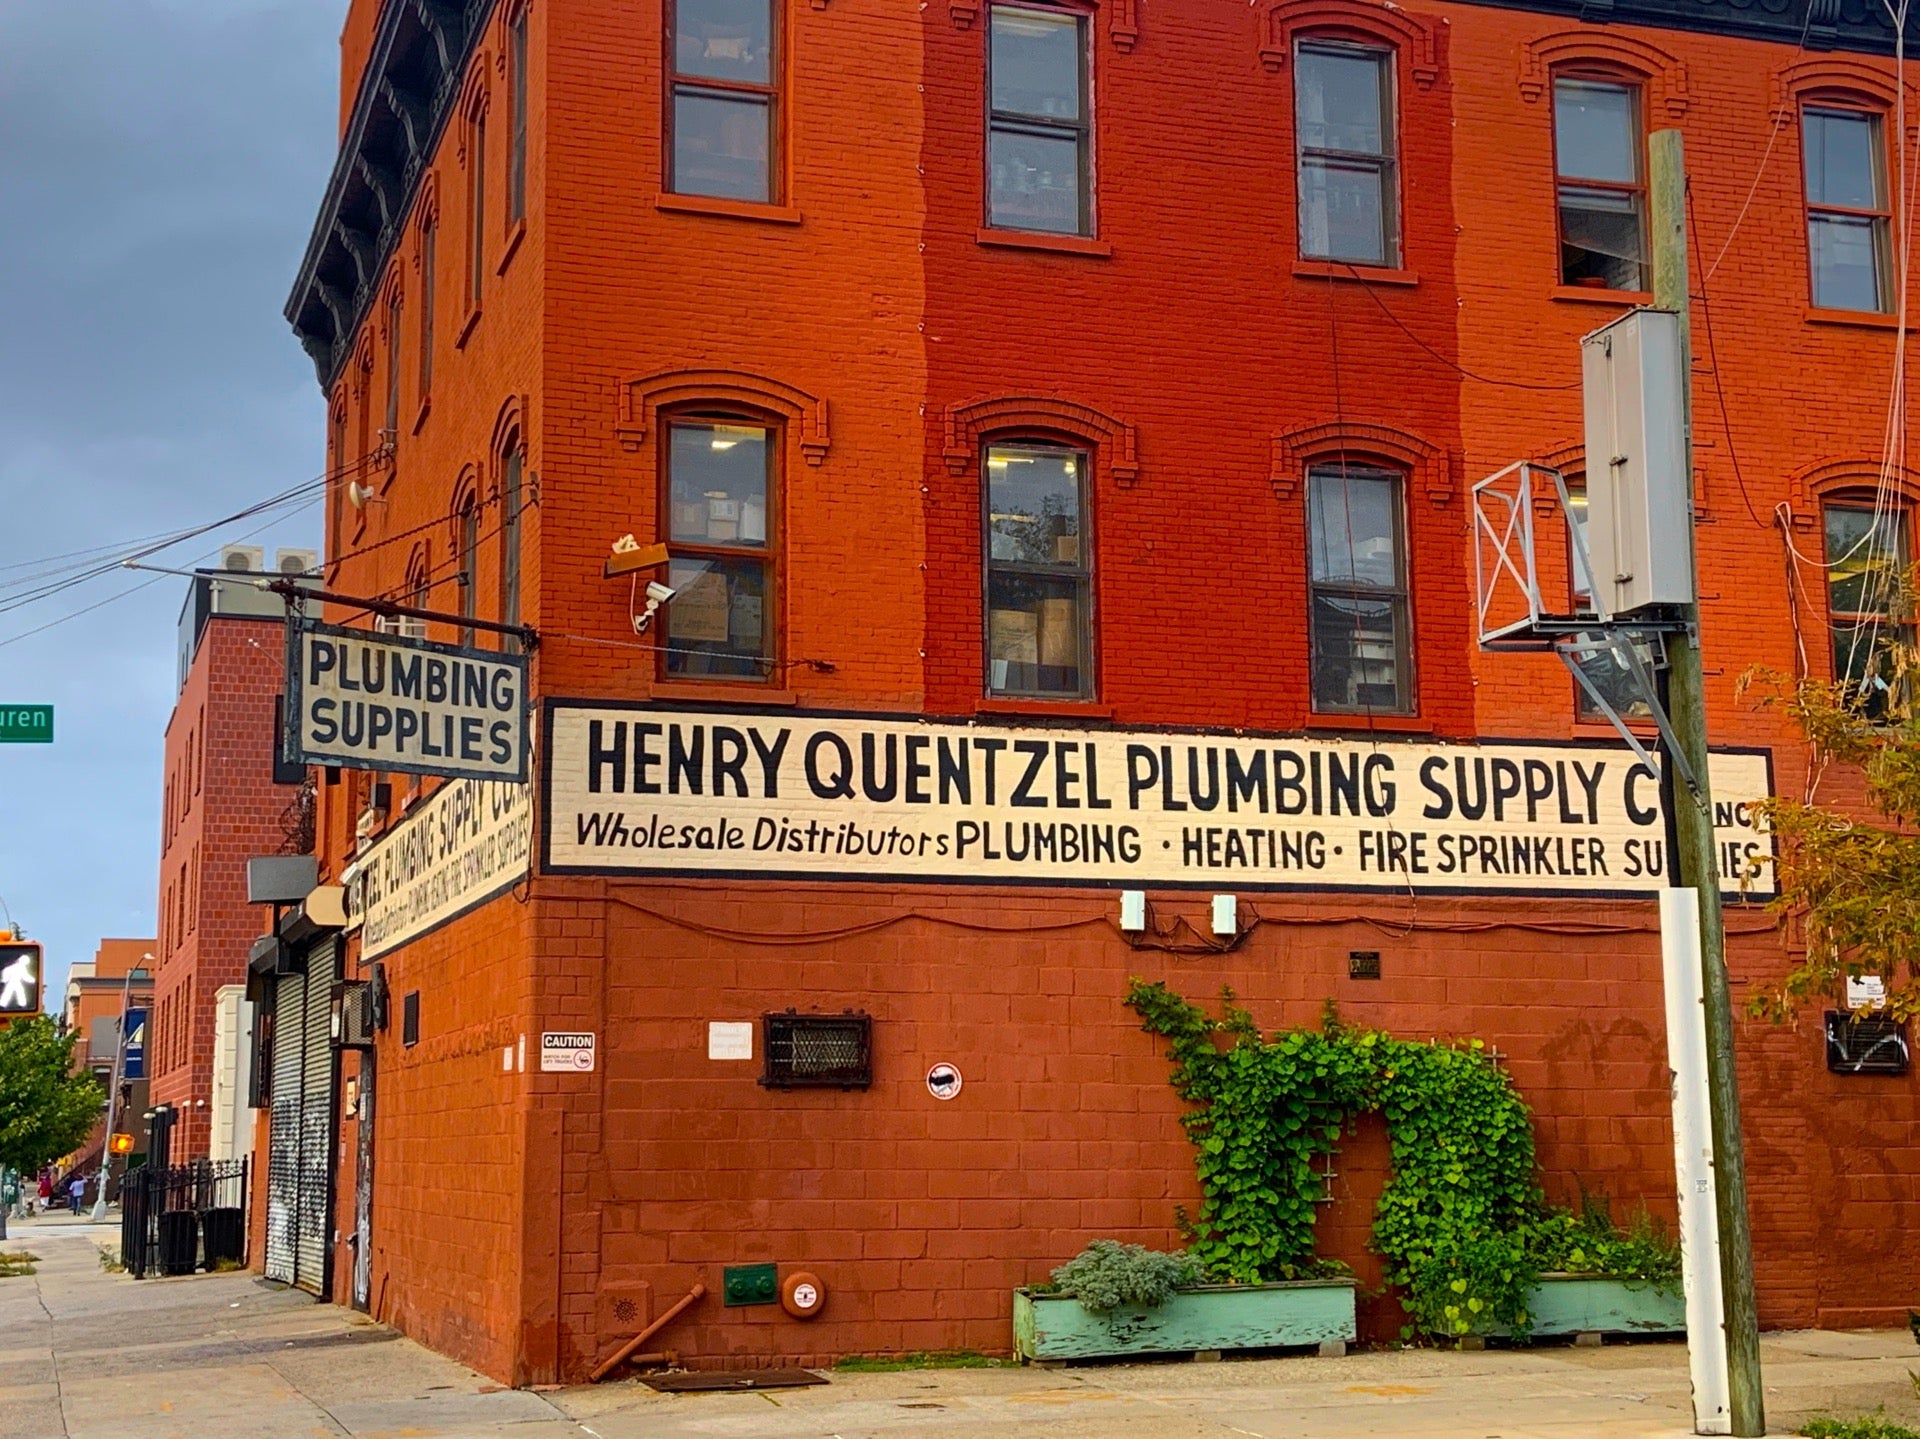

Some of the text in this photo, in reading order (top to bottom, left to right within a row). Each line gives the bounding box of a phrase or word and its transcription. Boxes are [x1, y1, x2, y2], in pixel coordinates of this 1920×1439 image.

[309, 639, 515, 712] PLUMBING
[310, 697, 512, 765] SUPPLIES
[588, 719, 792, 799] HENRY
[804, 730, 1112, 810] QUENTZEL
[1126, 744, 1397, 818] PLUMBING
[1419, 755, 1607, 825] SUPPLY
[1623, 762, 1658, 826] C
[384, 811, 435, 898] PLUMBING
[439, 779, 484, 861] SUPPLY
[577, 811, 1762, 880] Wholesale Distributors PLUMBING HEATING FIRE SPRINKLER SUIES
[545, 1036, 592, 1047] CAUTION
